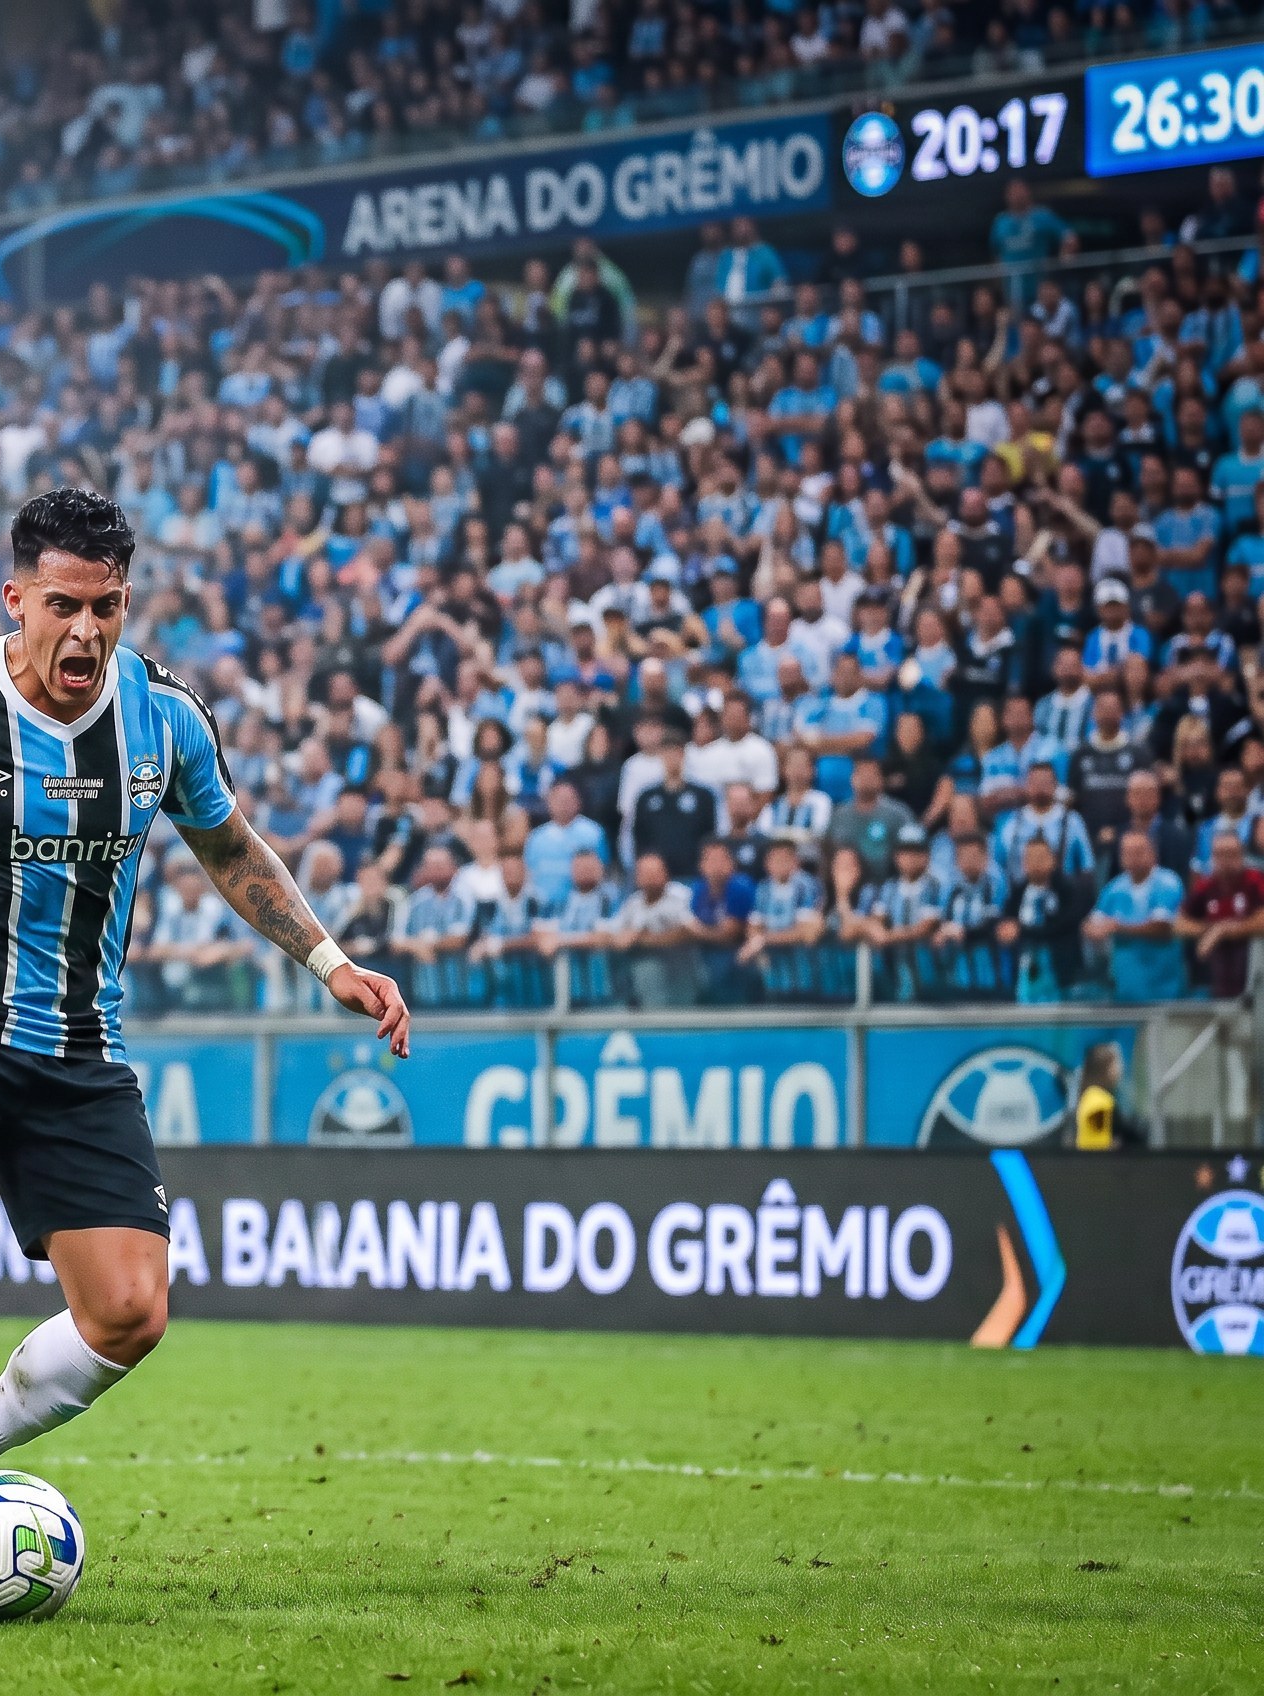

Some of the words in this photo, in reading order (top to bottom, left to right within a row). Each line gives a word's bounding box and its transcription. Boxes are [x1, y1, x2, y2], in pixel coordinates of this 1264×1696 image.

[911, 92, 1069, 182] 20:17
[1111, 67, 1264, 155] 26:30
[342, 172, 519, 256] ARENA
[525, 160, 608, 232] DO
[613, 128, 824, 220] GRÊMIO
[523, 1200, 636, 1296] DO
[647, 1178, 953, 1300] GRÊMIO
